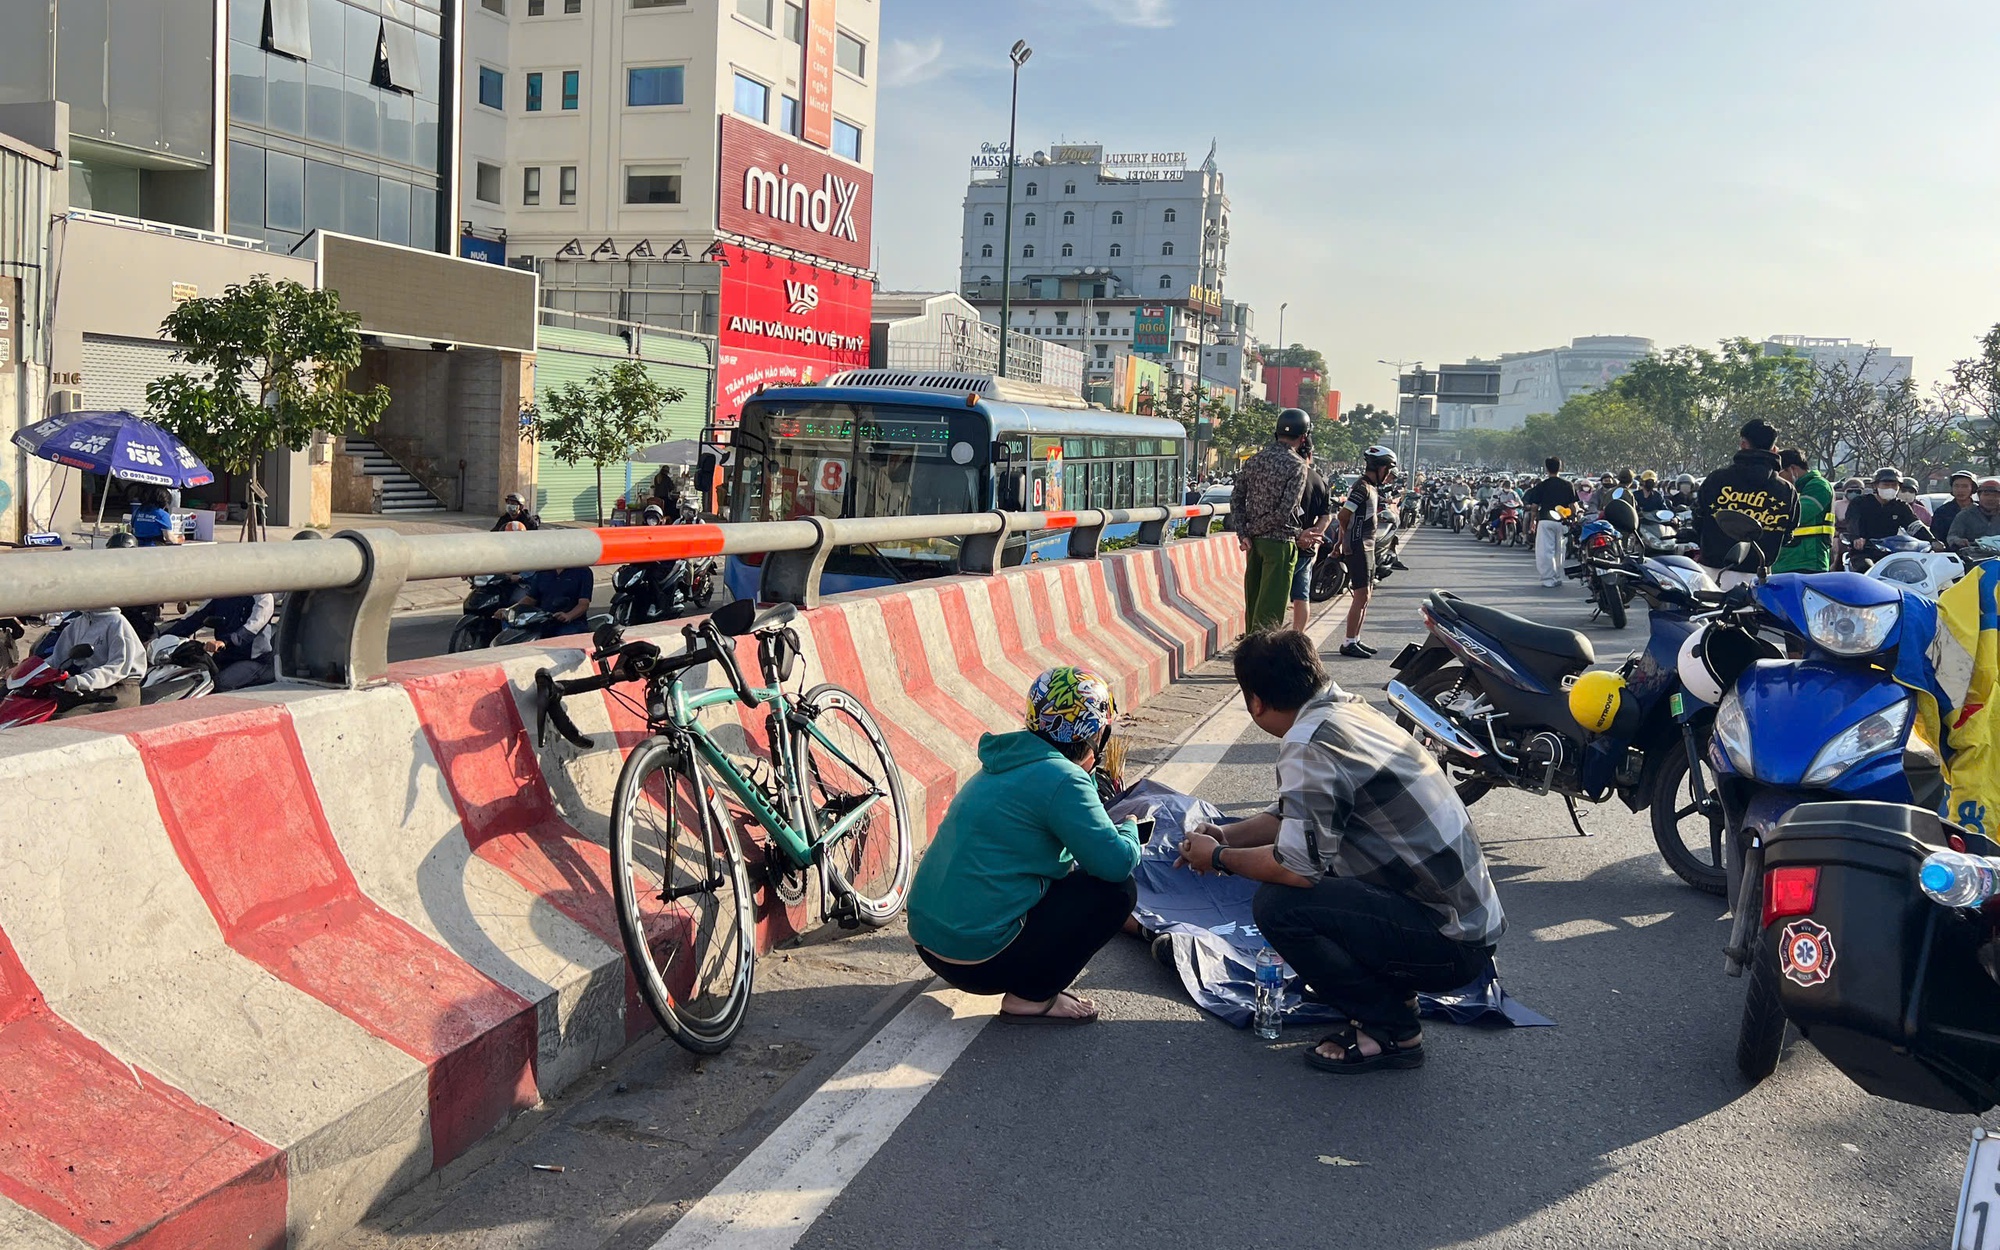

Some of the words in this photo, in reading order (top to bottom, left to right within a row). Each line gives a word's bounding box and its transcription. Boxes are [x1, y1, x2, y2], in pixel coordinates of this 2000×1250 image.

[809, 95, 829, 114] MindX
[970, 155, 1022, 167] MASSAE
[1105, 153, 1148, 164] LUXURY
[1151, 152, 1188, 163] HOTEL
[743, 163, 859, 242] mindX
[784, 279, 819, 308] VUS
[1190, 283, 1222, 307] HOTEL
[730, 316, 763, 335] ANH
[765, 321, 794, 340] VĂN
[795, 326, 817, 345] HỘI
[818, 330, 845, 350] VIỆT
[845, 336, 864, 351] MỸ
[126, 447, 163, 467] 15K
[821, 461, 843, 491] 8
[1035, 480, 1041, 505] 8
[1717, 486, 1768, 508] South
[1596, 693, 1615, 728] NEUTROVIS
